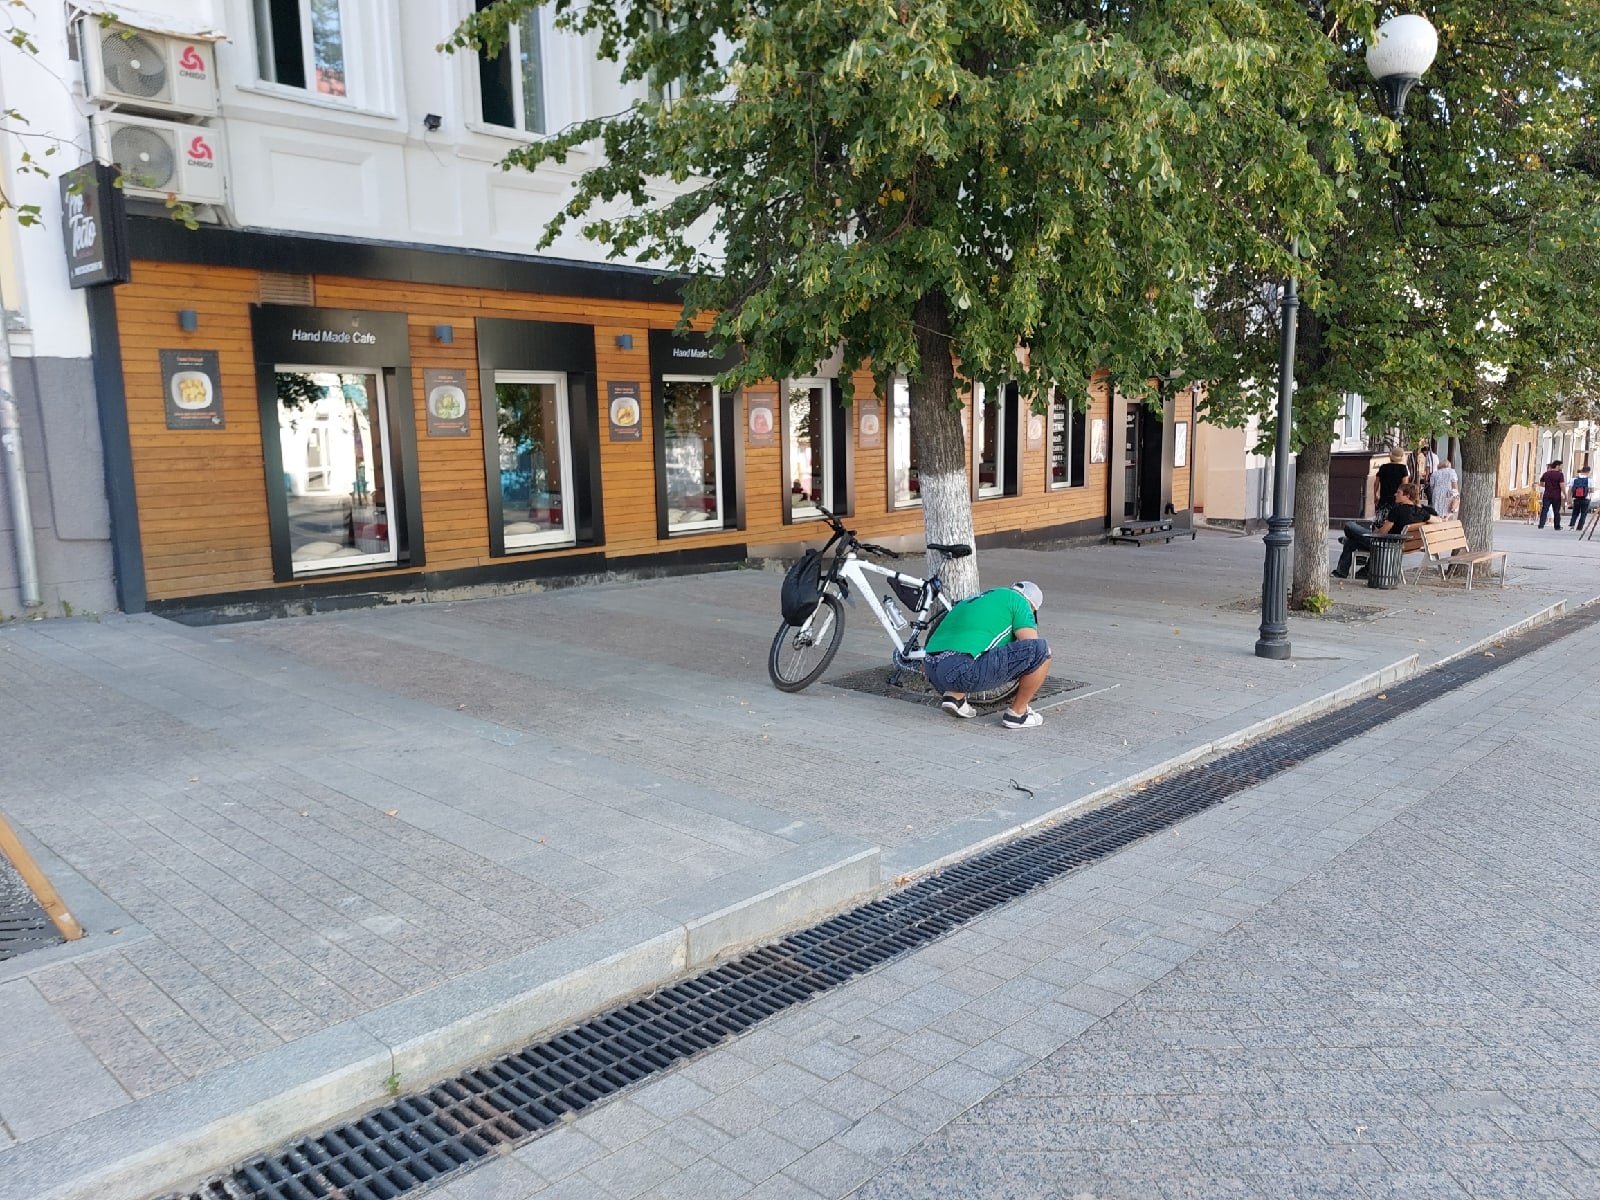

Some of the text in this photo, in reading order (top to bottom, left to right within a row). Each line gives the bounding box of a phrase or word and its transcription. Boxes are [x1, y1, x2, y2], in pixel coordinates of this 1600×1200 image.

[187, 159, 214, 169] CHIGO
[291, 328, 376, 345] Hand Made Cafe
[672, 347, 690, 358] Hand
[690, 348, 708, 359] Made
